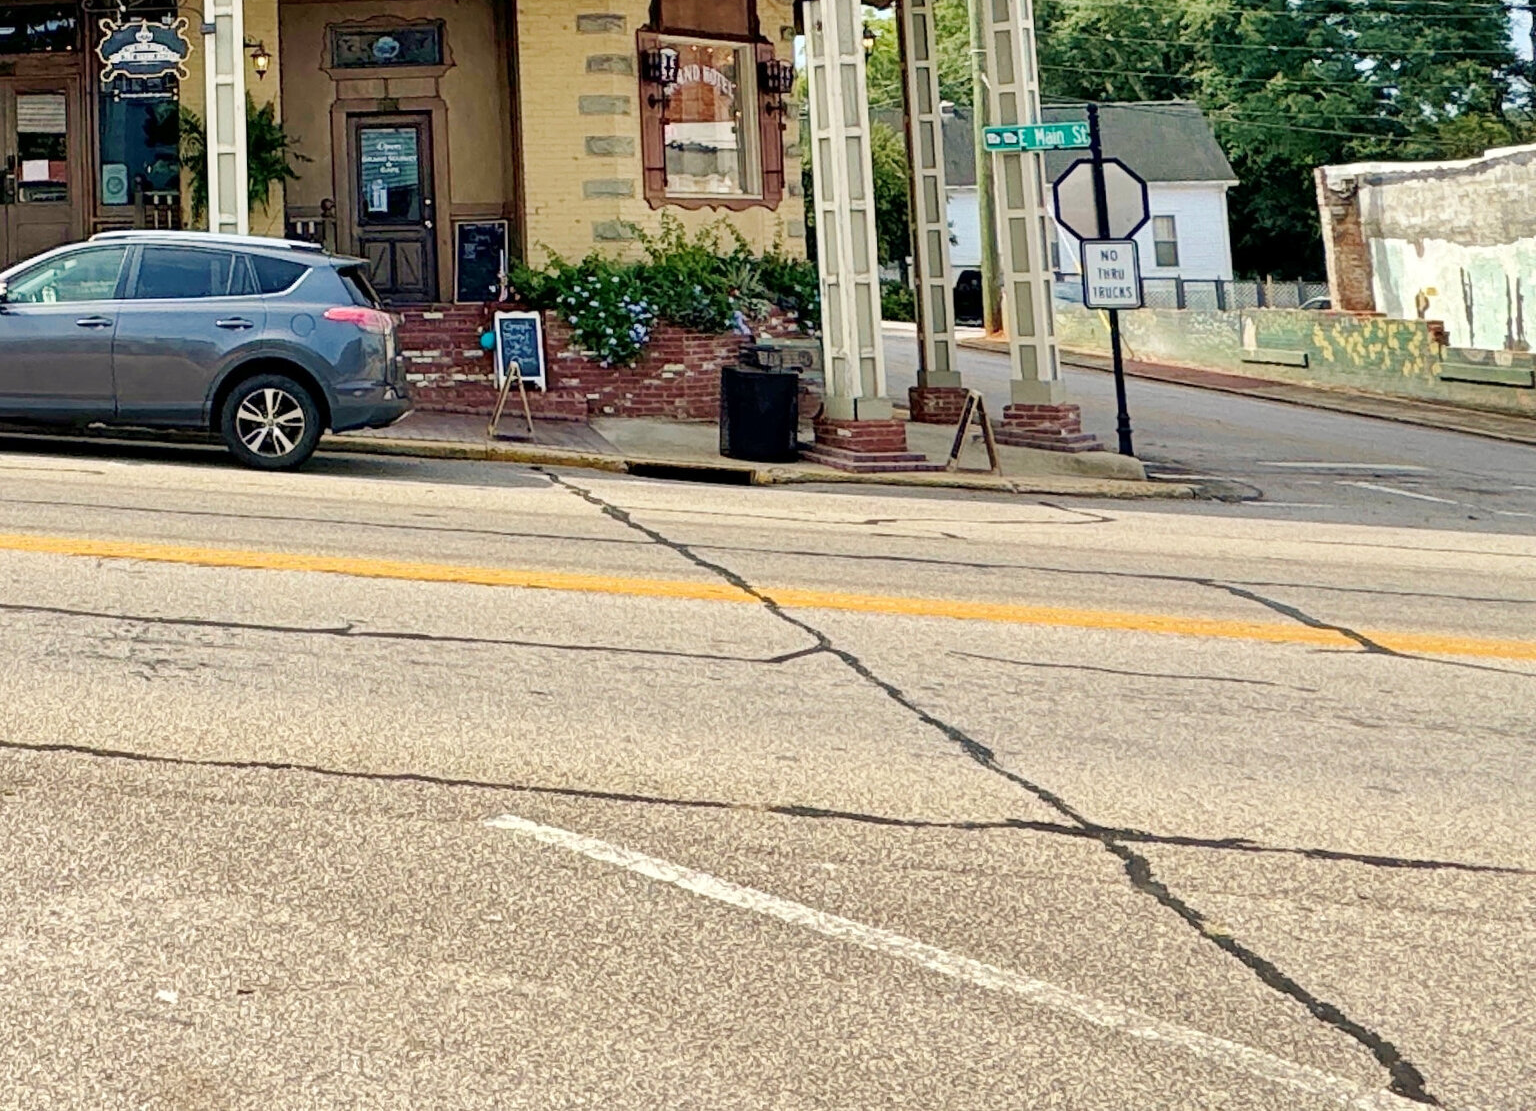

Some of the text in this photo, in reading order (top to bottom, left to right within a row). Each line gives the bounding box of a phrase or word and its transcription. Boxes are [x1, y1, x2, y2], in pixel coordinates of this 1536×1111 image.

[1018, 129, 1028, 146] E
[1034, 127, 1064, 146] Main
[1072, 125, 1088, 144] St
[1101, 250, 1117, 262] NO
[1098, 267, 1125, 280] THRU
[1093, 286, 1132, 299] TRUCKS
